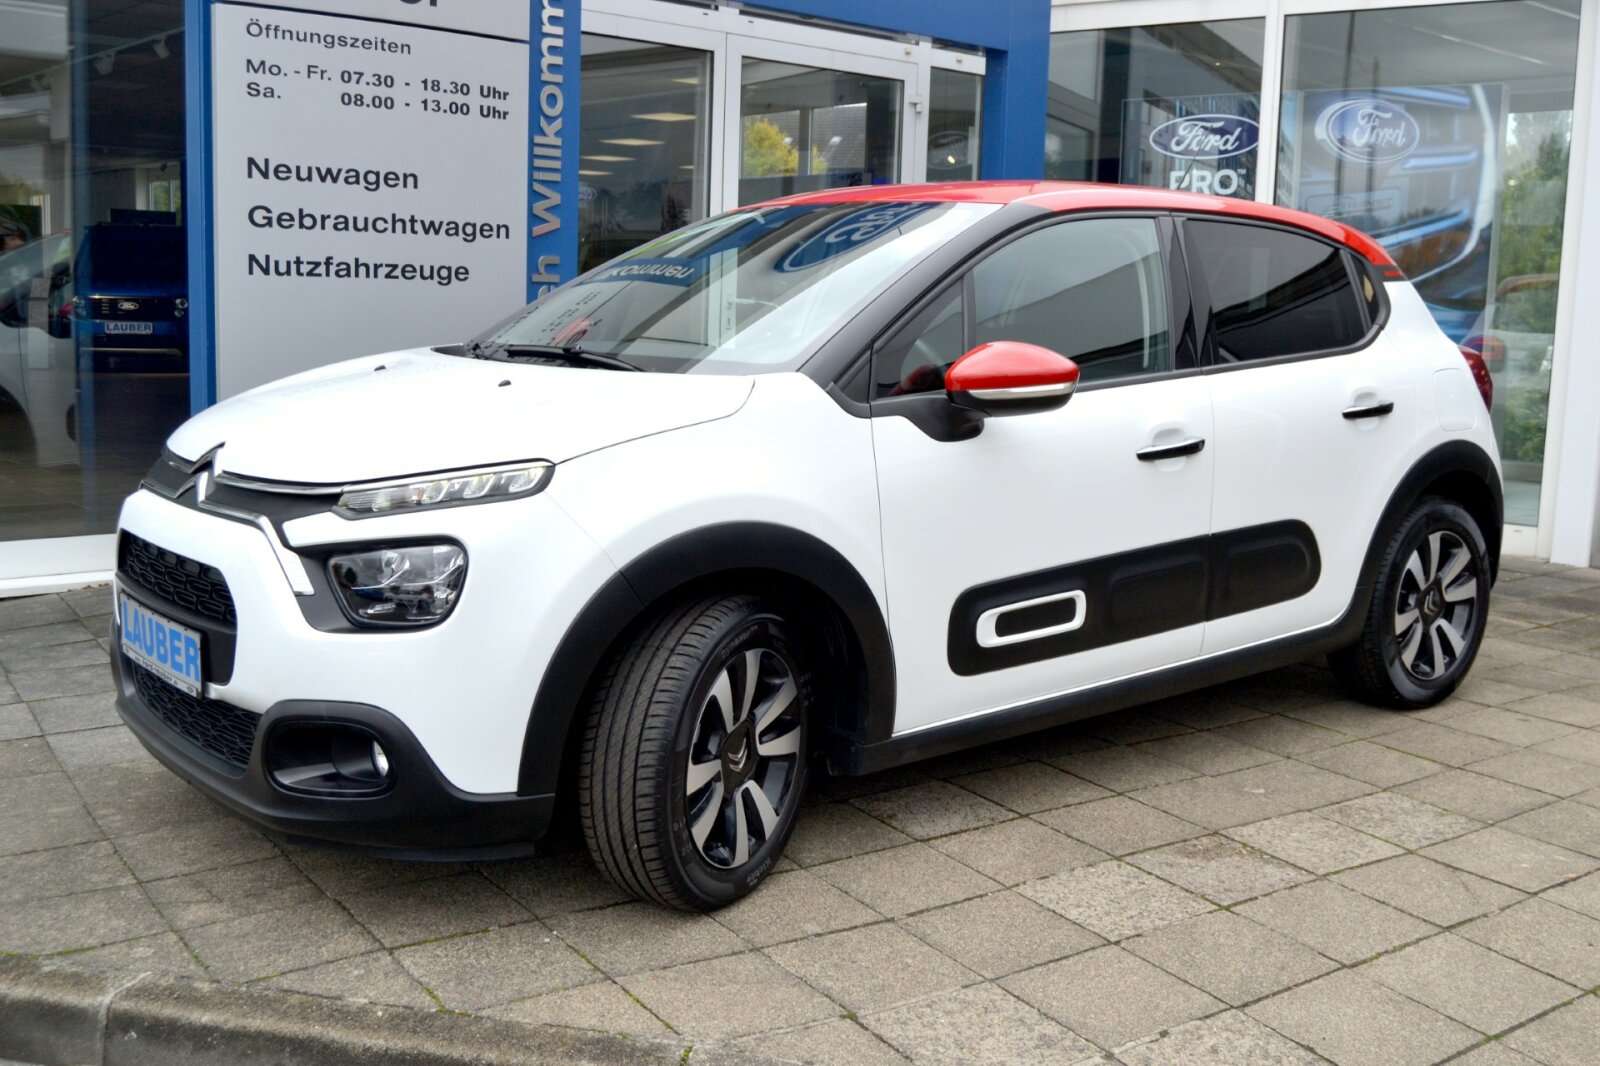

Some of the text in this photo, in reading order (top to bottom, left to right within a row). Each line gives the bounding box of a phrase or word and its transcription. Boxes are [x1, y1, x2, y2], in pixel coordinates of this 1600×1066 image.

[246, 18, 411, 56] Öffnungszeiten
[246, 59, 288, 77] Mo.
[307, 65, 332, 82] Fr.
[340, 69, 395, 89] 07.30
[420, 77, 471, 97] 18.30
[479, 84, 510, 101] Uhr
[246, 81, 281, 99] Sa.
[340, 92, 395, 110] 08.00
[420, 98, 471, 116] 13.00
[479, 104, 510, 121] Uhr
[1170, 120, 1243, 152] Ford
[247, 156, 419, 193] Neuwagen
[247, 204, 510, 244] Gebrauchtwagen
[247, 253, 470, 287] Nutzfahrzeuge
[106, 321, 152, 333] LAUBER
[123, 598, 201, 682] LAUBER
